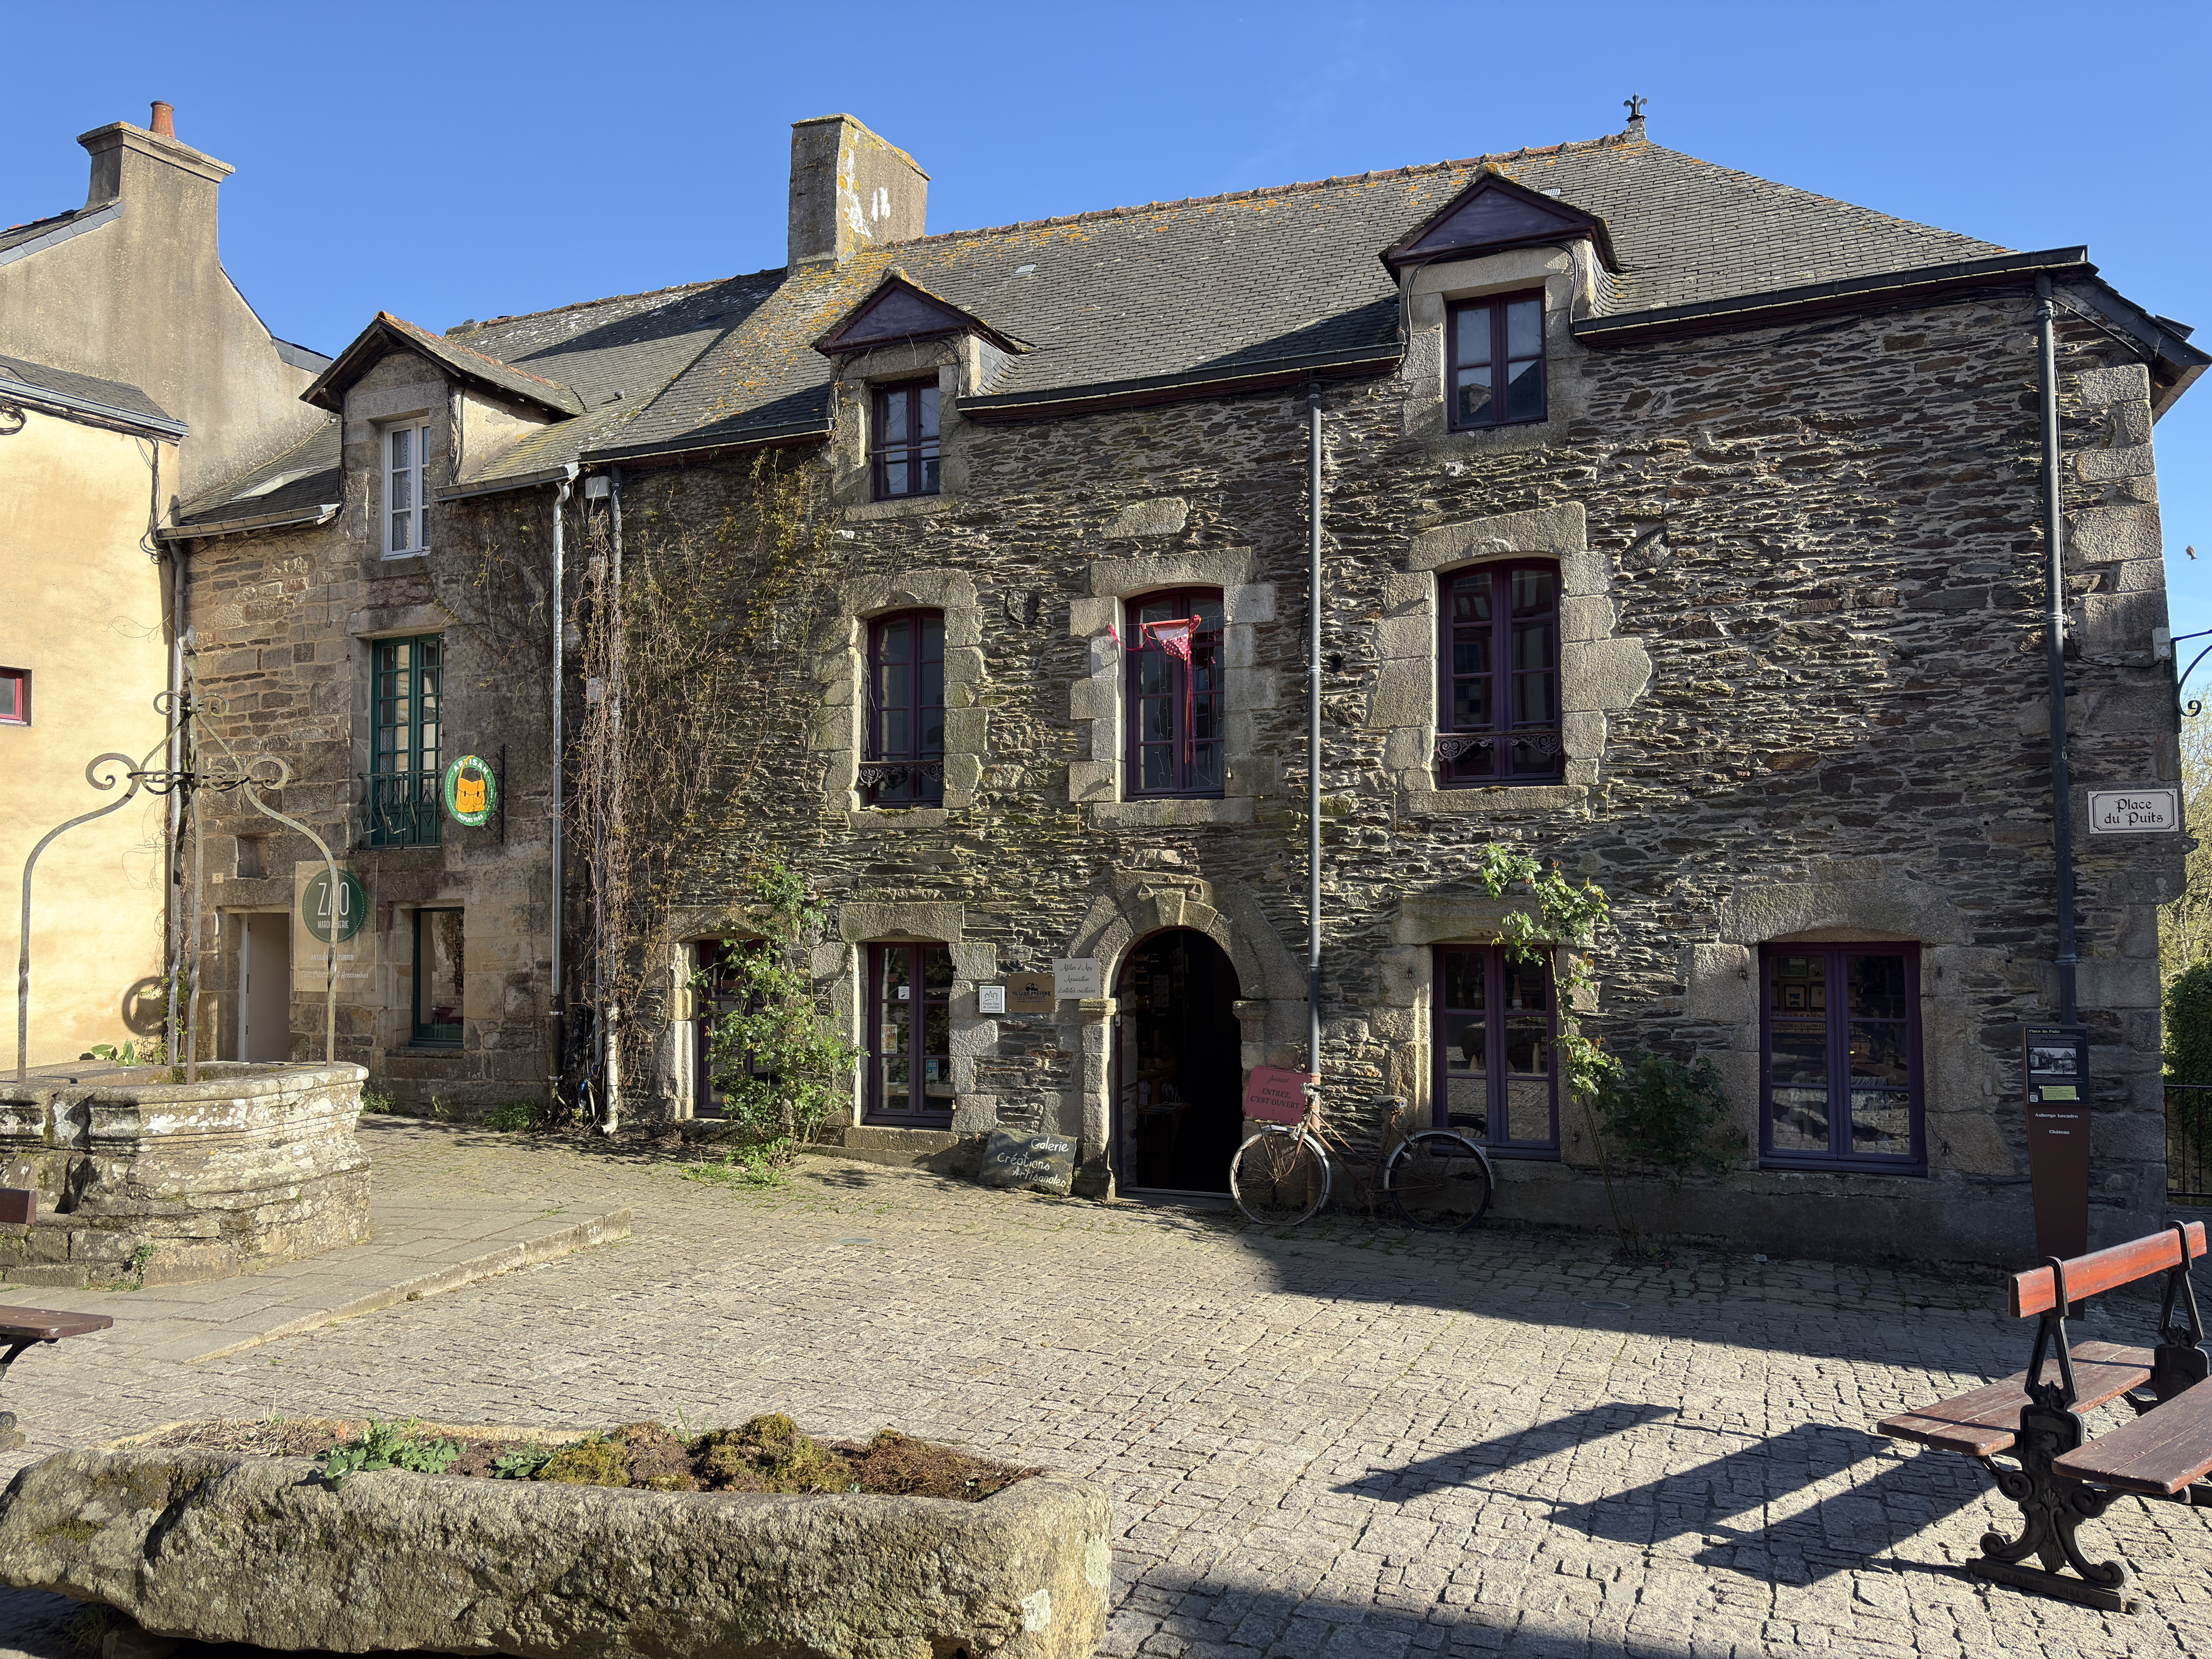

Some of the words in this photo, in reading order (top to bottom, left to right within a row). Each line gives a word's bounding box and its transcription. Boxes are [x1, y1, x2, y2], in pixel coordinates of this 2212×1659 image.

[2114, 798, 2152, 812] Place
[457, 813, 473, 823] DEPUIS
[473, 814, 483, 822] 1985
[2104, 812, 2120, 824] du
[2125, 812, 2163, 826] Puits
[317, 920, 349, 928] MAROERIE
[1060, 963, 1076, 972] Atelier
[313, 970, 328, 979] Ceintu
[341, 971, 369, 980] Accessoires
[1063, 974, 1089, 983] Association
[1250, 1095, 1270, 1104] C'EST
[1271, 1099, 1300, 1109] OUVERT
[1031, 1136, 1069, 1152] Galerie
[997, 1151, 1050, 1171] Créations
[1011, 1166, 1066, 1187] Artisanales
